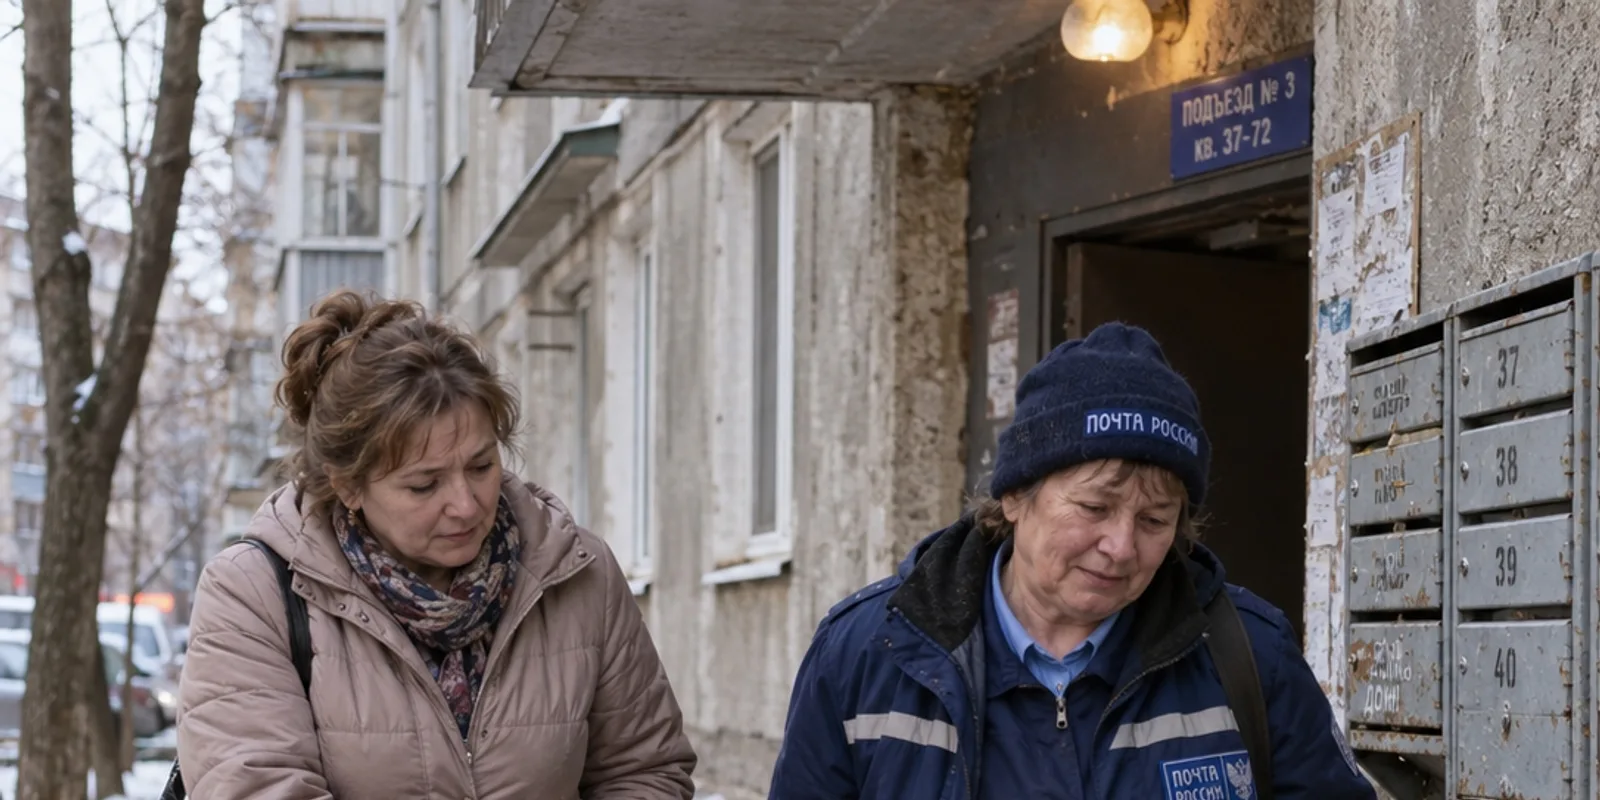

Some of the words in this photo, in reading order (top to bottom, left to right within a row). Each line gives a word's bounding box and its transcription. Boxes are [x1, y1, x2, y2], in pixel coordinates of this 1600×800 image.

[1182, 83, 1254, 127] ПОДЪЕЗД
[1260, 78, 1279, 105] №
[1285, 71, 1295, 99] 3
[1222, 117, 1271, 155] 37-72
[1498, 345, 1519, 388] 37
[1087, 412, 1144, 434] ПОЧТА
[1496, 445, 1518, 488] 38
[1495, 546, 1517, 587] 39
[1494, 647, 1516, 689] 40
[1172, 765, 1220, 788] ПОЧТА
